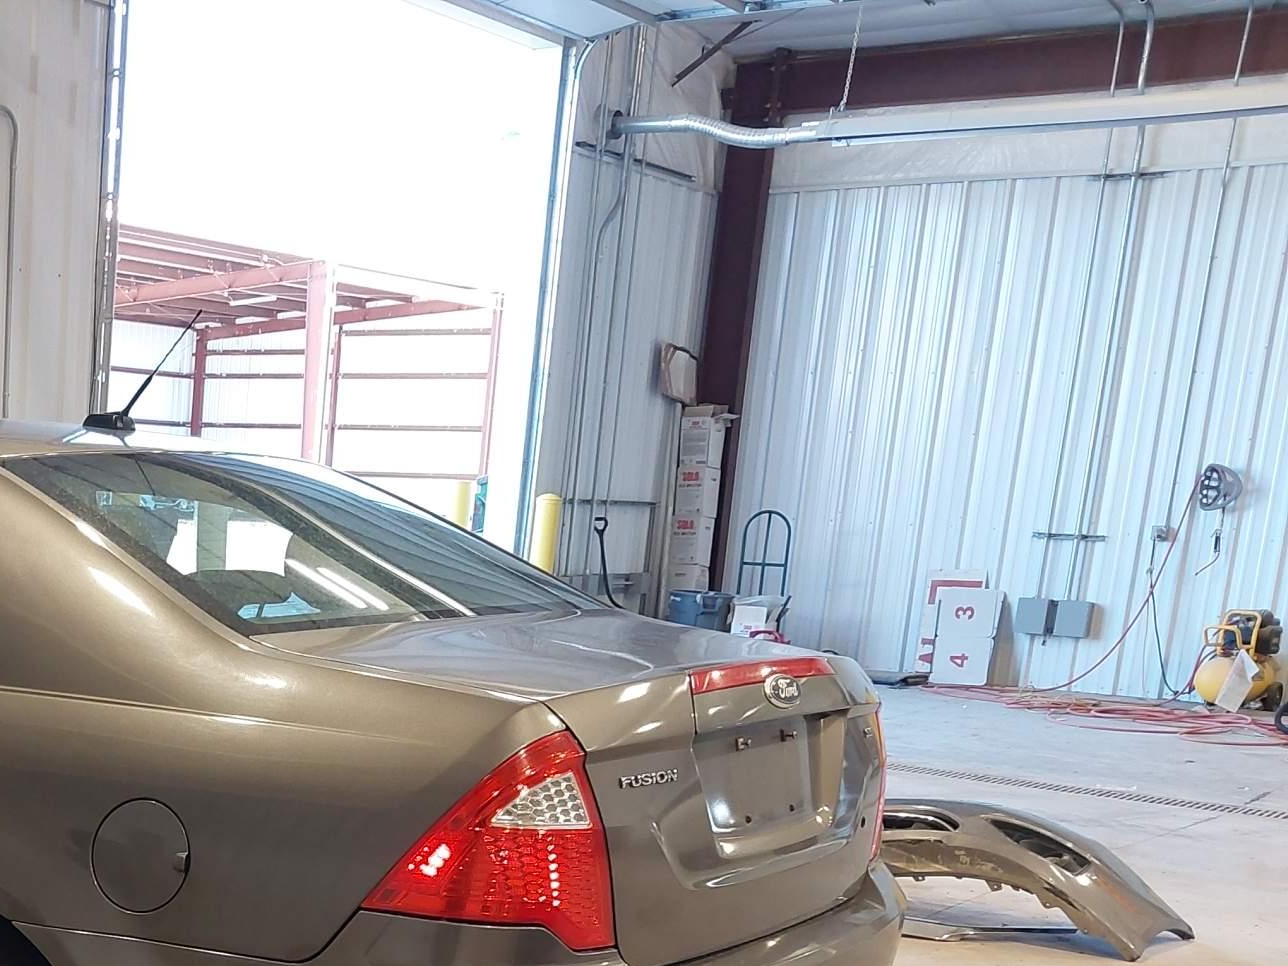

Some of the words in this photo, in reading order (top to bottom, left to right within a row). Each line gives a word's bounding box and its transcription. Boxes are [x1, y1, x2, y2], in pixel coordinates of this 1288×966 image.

[955, 606, 975, 620] 3
[949, 653, 969, 668] 4
[619, 768, 679, 789] FUSION
